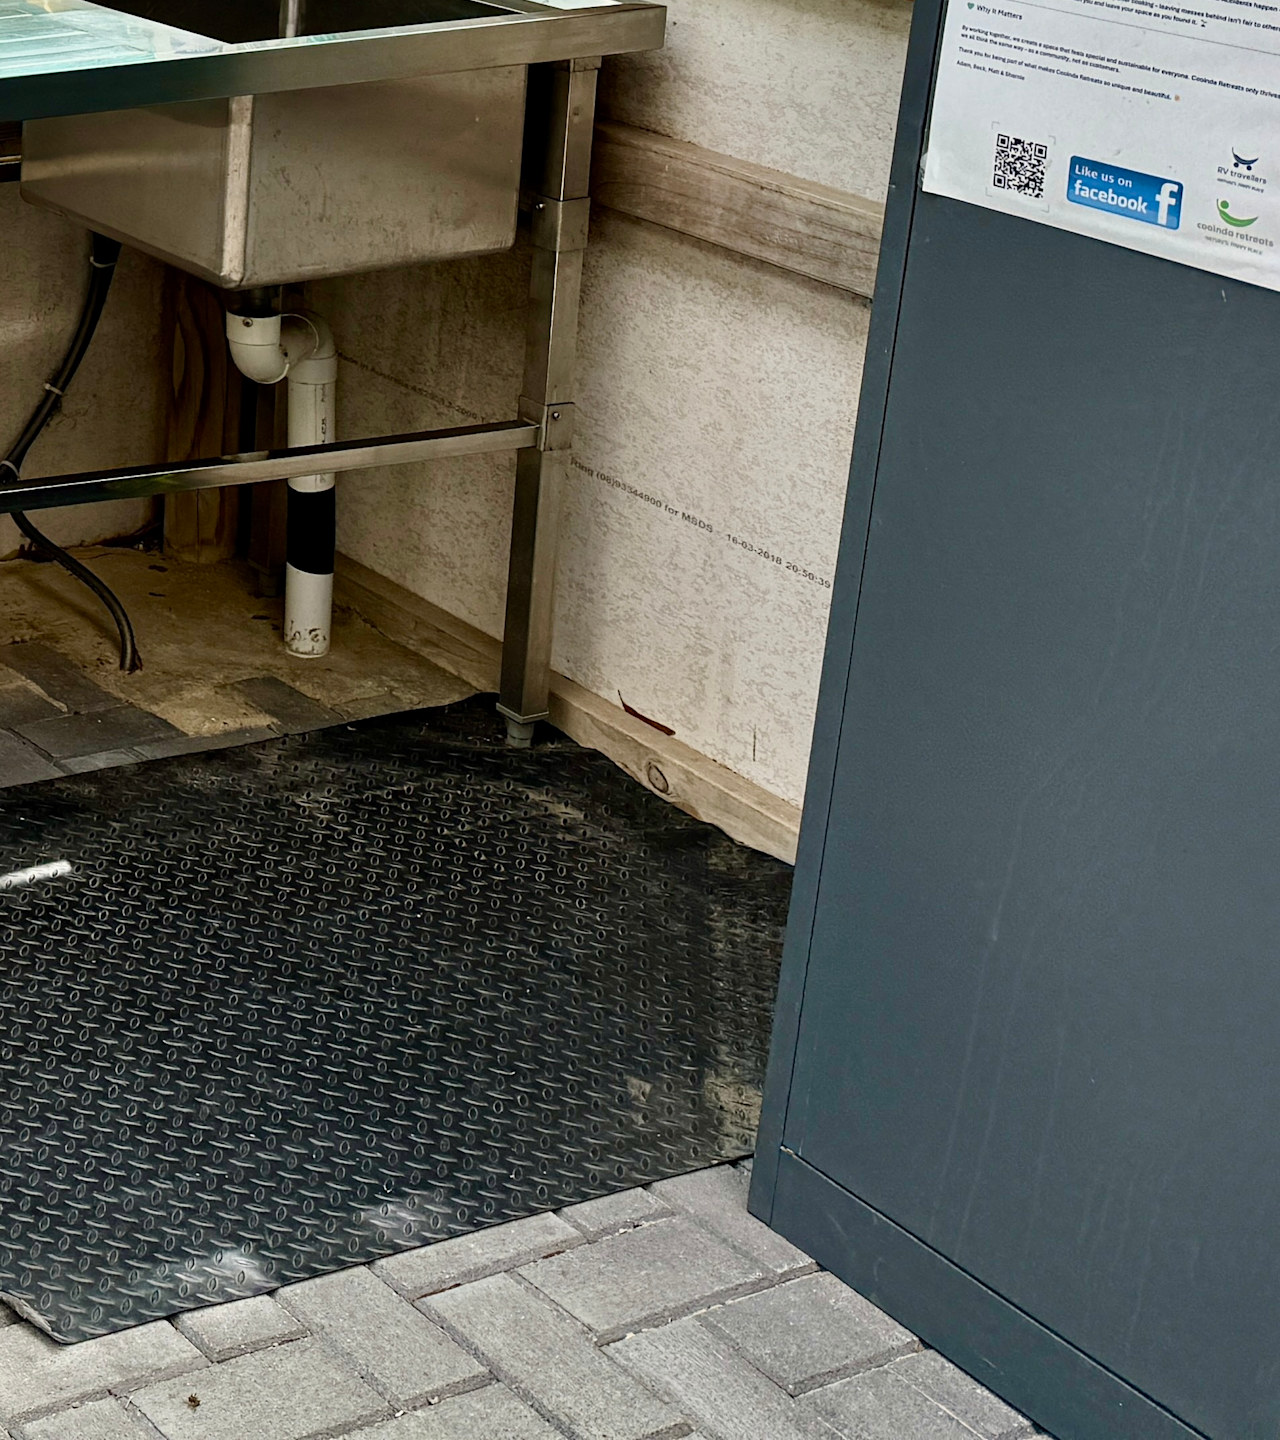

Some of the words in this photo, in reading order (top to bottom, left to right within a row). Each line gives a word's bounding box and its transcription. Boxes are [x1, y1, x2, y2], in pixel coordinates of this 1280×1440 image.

[976, 4, 991, 14] Why
[997, 8, 1022, 20] Matters
[1074, 163, 1098, 179] Like
[1100, 172, 1114, 183] us
[1117, 177, 1132, 188] on
[1216, 165, 1229, 175] RV
[1229, 169, 1267, 184] travellers
[1074, 180, 1148, 213] facebook
[1196, 222, 1234, 237] cooinda
[1235, 231, 1274, 247] retreats
[665, 504, 679, 516] for
[681, 512, 714, 532] MSDS
[727, 534, 782, 565] 16-03-2018
[785, 562, 831, 588] 20:50:39
